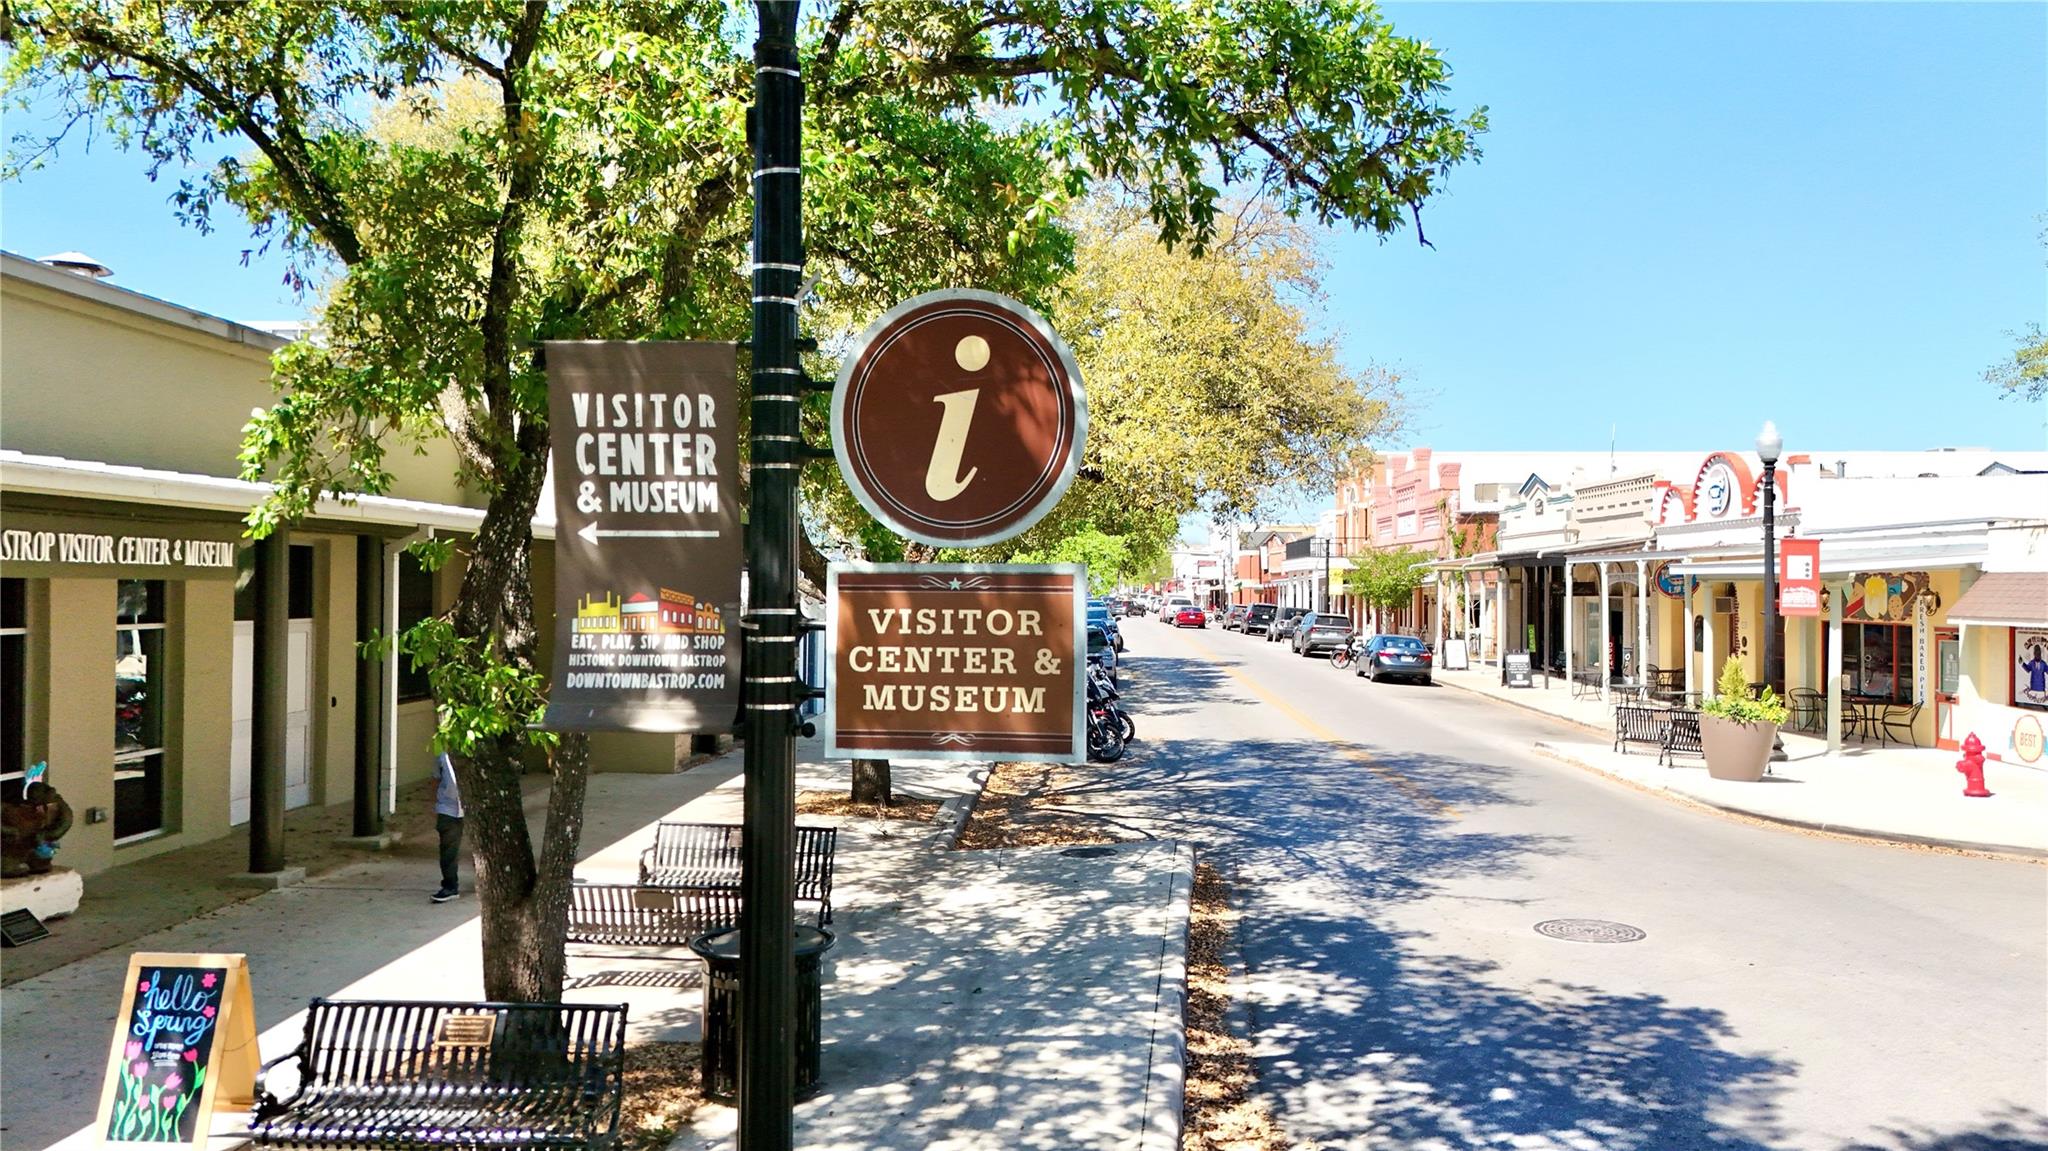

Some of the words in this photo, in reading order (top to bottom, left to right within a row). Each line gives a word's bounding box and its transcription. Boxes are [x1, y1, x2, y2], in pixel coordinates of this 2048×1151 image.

[571, 392, 717, 428] VISITOR
[575, 432, 718, 476] CENTER
[577, 480, 603, 513] &
[610, 481, 719, 513] MUSEUM
[0, 529, 55, 562] STROP
[59, 533, 115, 564] VISITOR
[118, 536, 171, 566] CENTER
[173, 539, 183, 561] &
[184, 540, 234, 567] MUSEUM
[868, 608, 1043, 636] VISITOR
[571, 634, 597, 650] EAT,
[602, 635, 635, 650] PLAY,
[640, 635, 660, 650] SIP
[663, 635, 689, 650] AND
[693, 635, 725, 650] SHOP
[569, 654, 615, 667] HISTORIC
[618, 654, 678, 667] DOWNTOWN
[681, 654, 726, 667] BASTROP
[849, 646, 1017, 674] CENTER
[1034, 648, 1061, 675] &
[567, 672, 725, 689] DOWNTOWNBASTROP.COM
[863, 685, 1046, 713] MUSEUM
[2019, 732, 2037, 748] BEST
[144, 970, 217, 1011] hello
